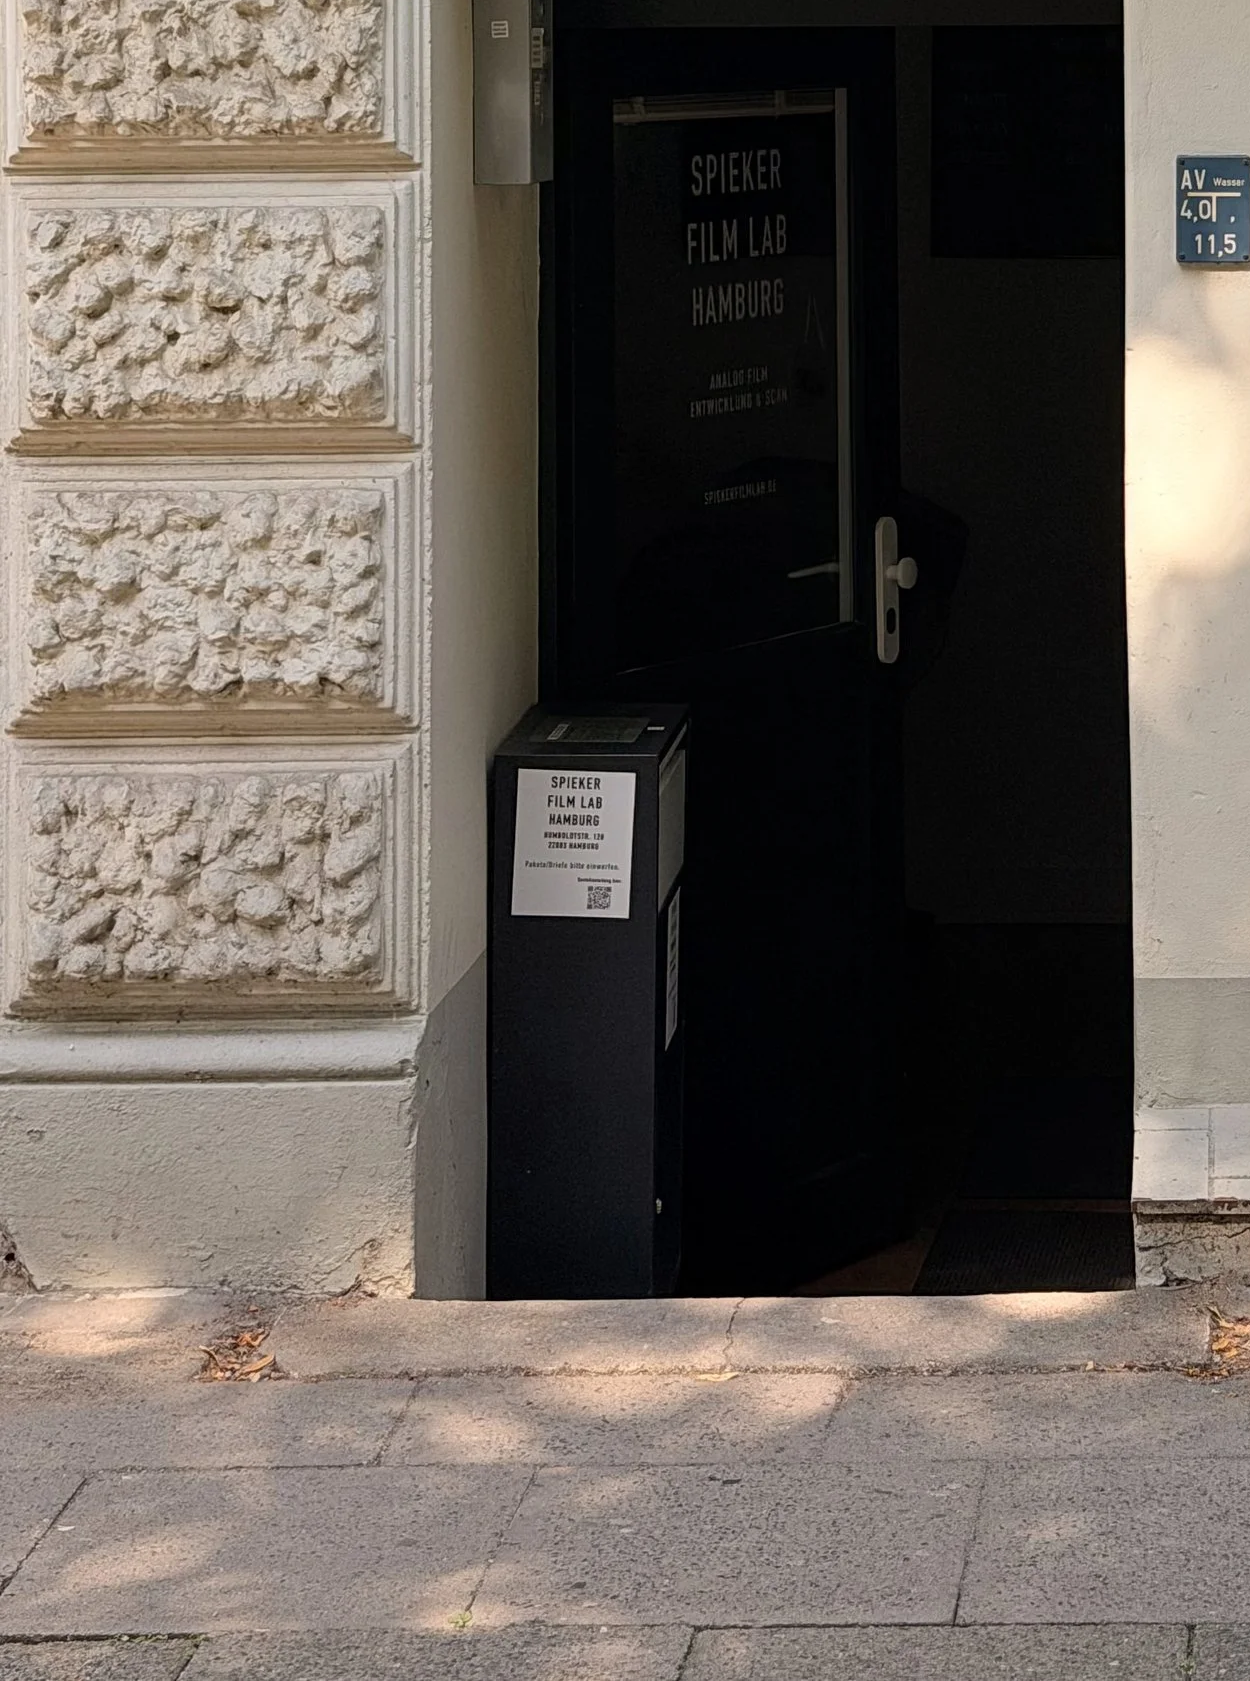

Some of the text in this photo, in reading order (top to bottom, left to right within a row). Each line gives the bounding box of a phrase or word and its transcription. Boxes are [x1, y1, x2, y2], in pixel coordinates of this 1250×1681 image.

[690, 147, 782, 197] SPIEKER
[1180, 168, 1245, 191] AV Wasser
[1180, 199, 1212, 223] 4,0
[687, 213, 788, 266] FILM LAB
[1194, 233, 1237, 258] 11,5
[691, 277, 785, 327] HAMBURG
[709, 365, 769, 391] ANALOG FILM
[689, 392, 753, 418] ENTWICKLUNG
[764, 387, 788, 406] SCAN
[551, 776, 601, 791] SPIEKER
[547, 795, 603, 809] FILM LAB
[549, 813, 600, 827] HAMBURG
[543, 831, 590, 841] HUMBOLDTSTR.
[568, 842, 600, 850] HAMBURG
